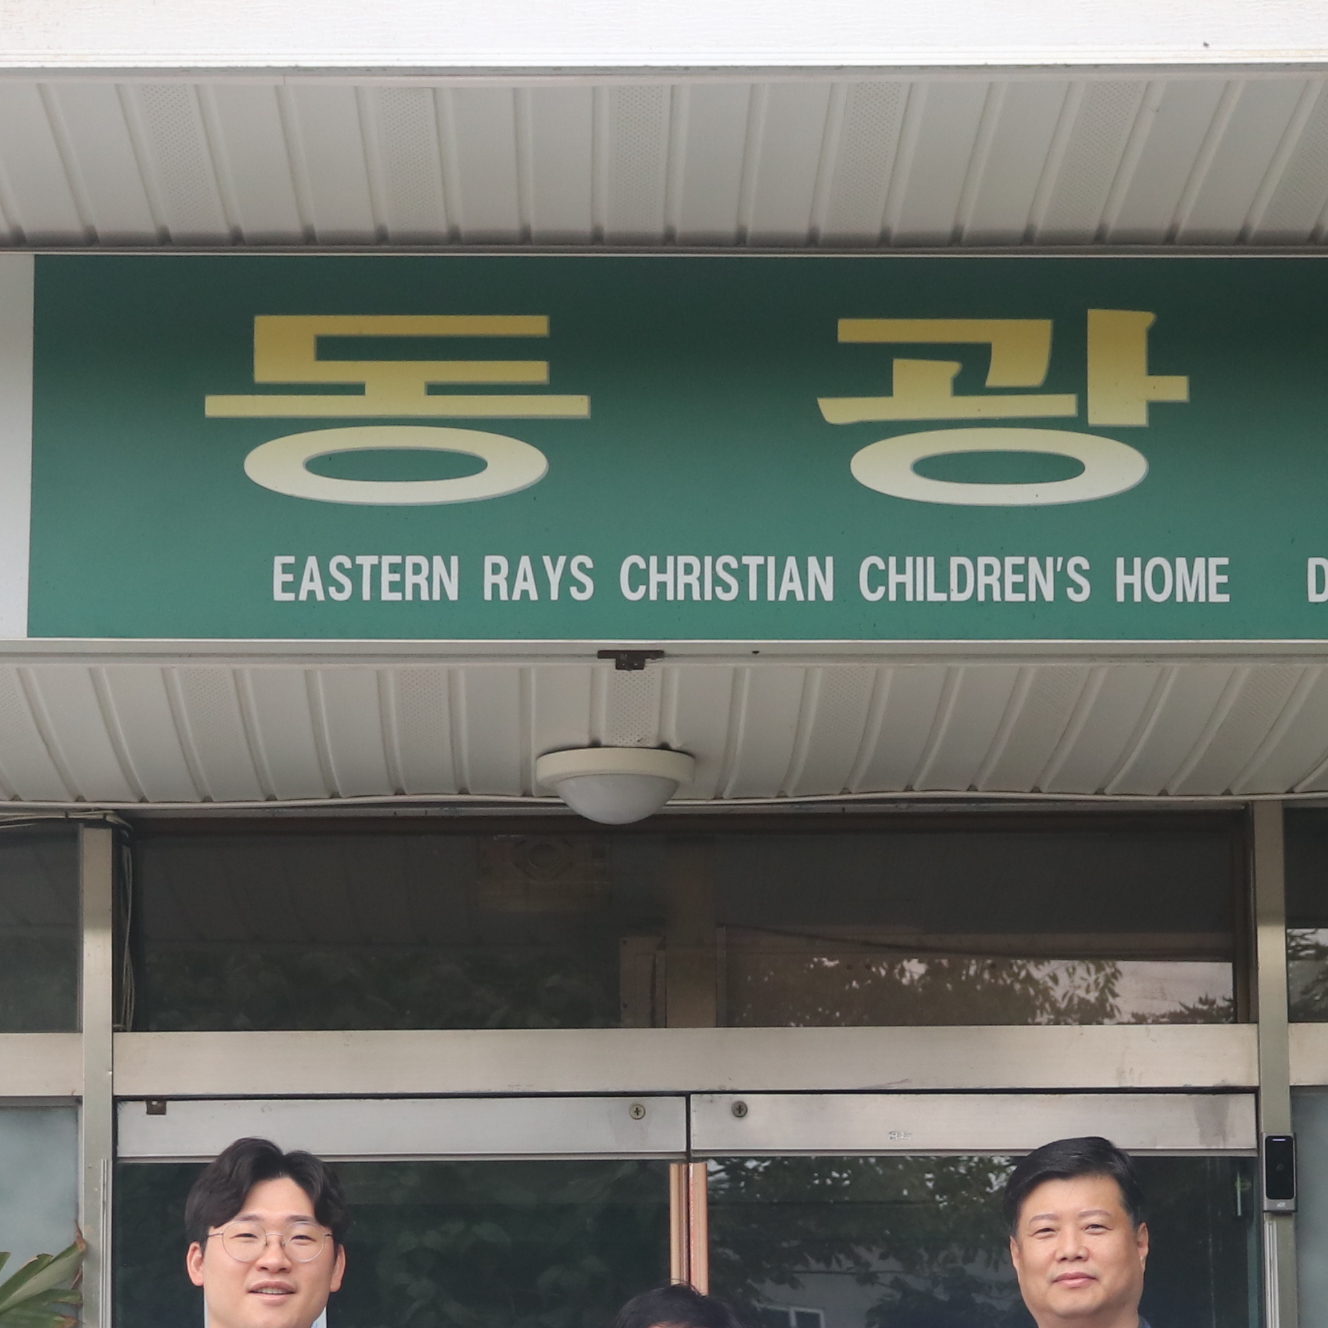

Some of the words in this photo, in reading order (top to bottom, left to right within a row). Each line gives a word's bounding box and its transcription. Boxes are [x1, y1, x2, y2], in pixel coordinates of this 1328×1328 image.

[273, 555, 459, 602] EASTERN
[484, 555, 593, 602] RAYS
[619, 555, 833, 602] CHRISTIAN
[858, 556, 1090, 604] CHILDREN'S
[1115, 556, 1230, 604] HOME
